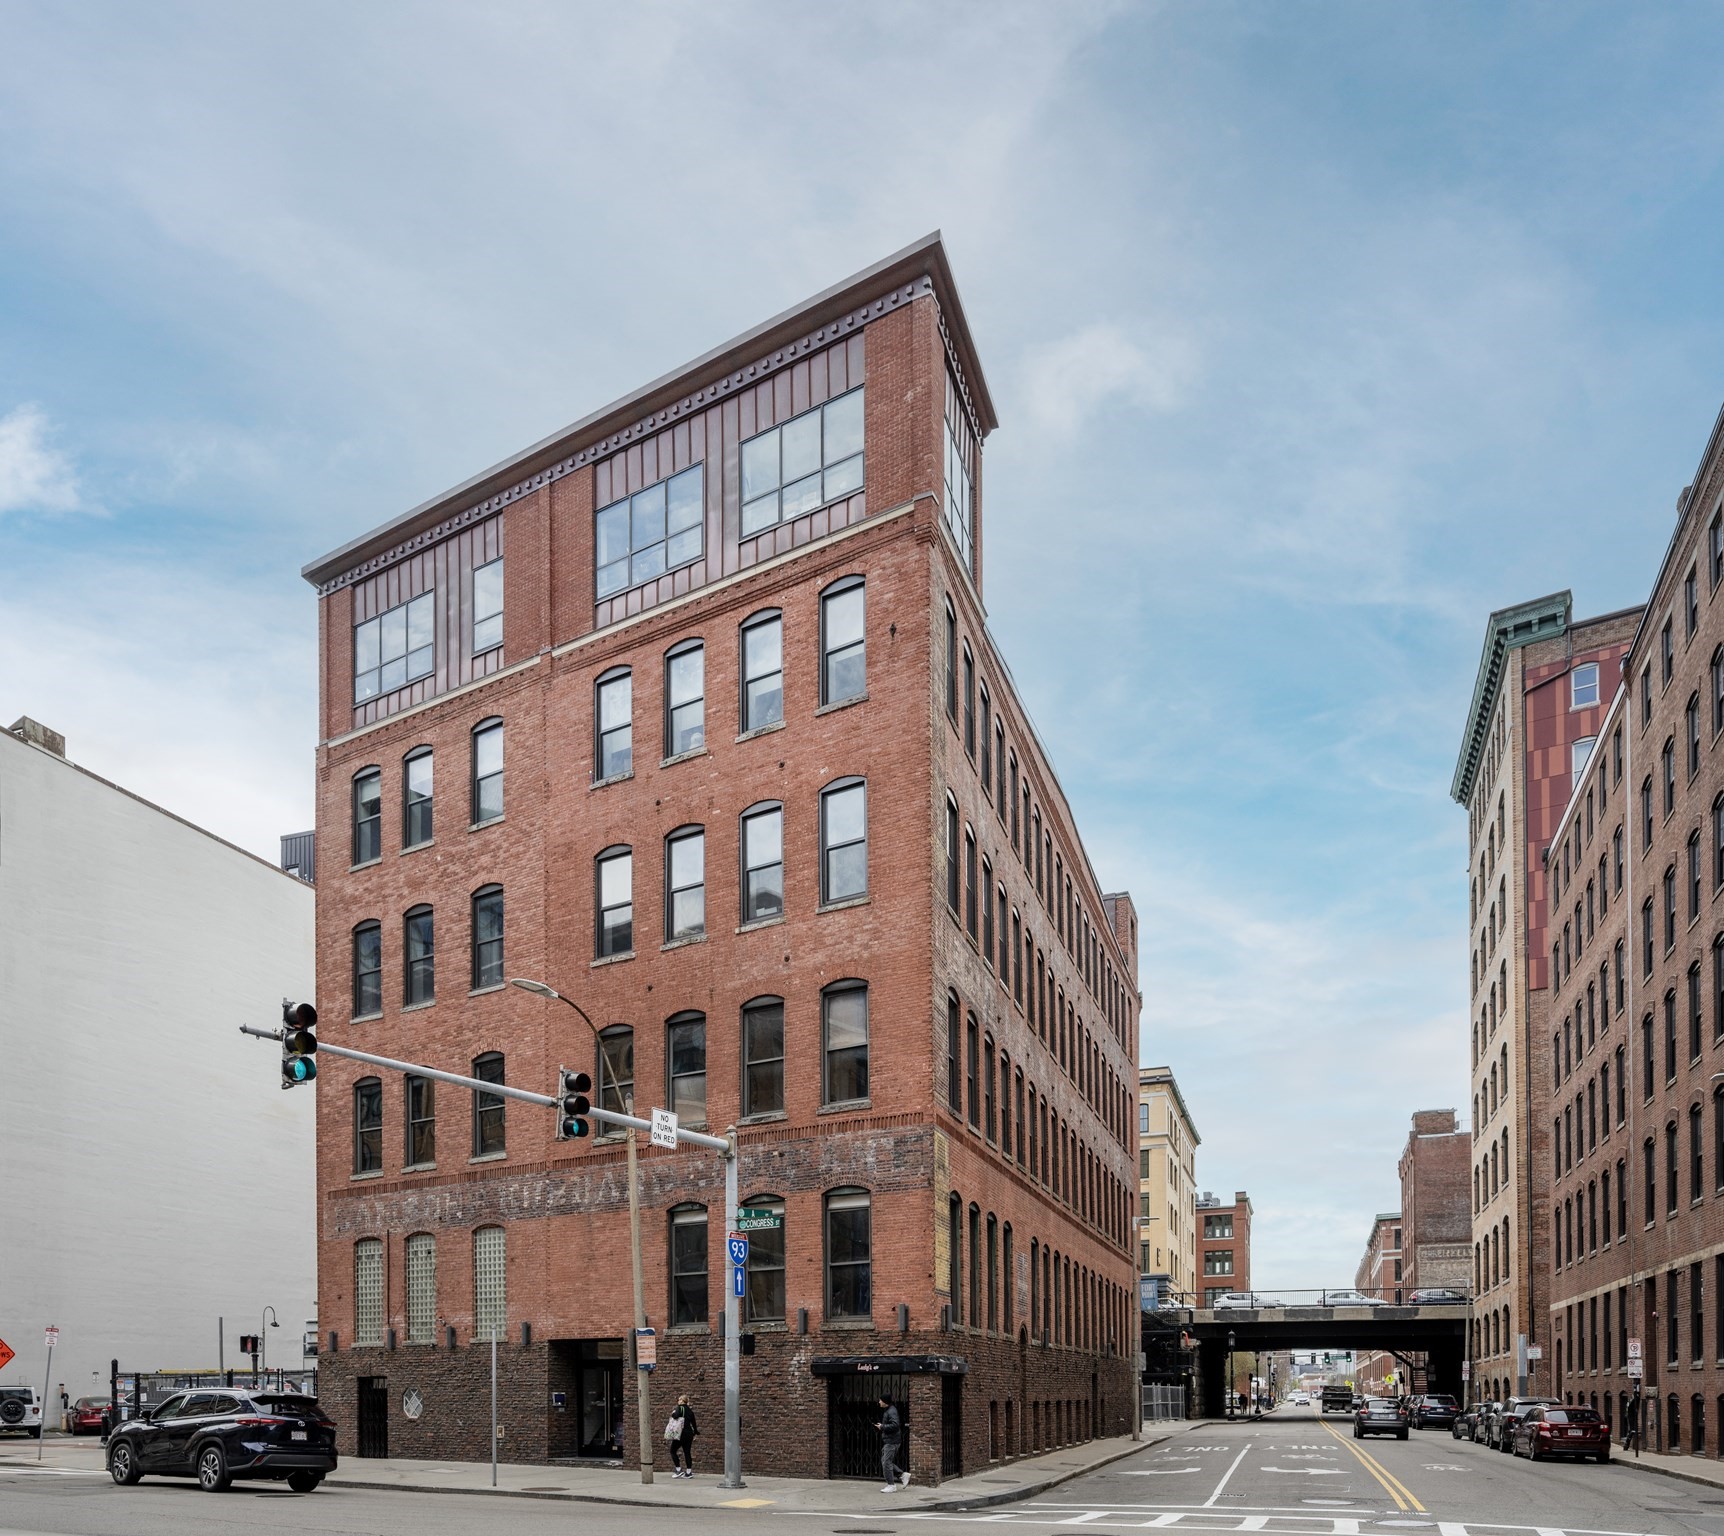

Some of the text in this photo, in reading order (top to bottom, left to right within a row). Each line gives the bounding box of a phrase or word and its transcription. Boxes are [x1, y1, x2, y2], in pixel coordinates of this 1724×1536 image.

[660, 1114, 669, 1122] NO
[657, 1123, 673, 1133] TURN
[653, 1132, 675, 1144] ON RED
[751, 1209, 755, 1217] A
[746, 1218, 774, 1228] CONGRESS
[731, 1241, 745, 1258] 93
